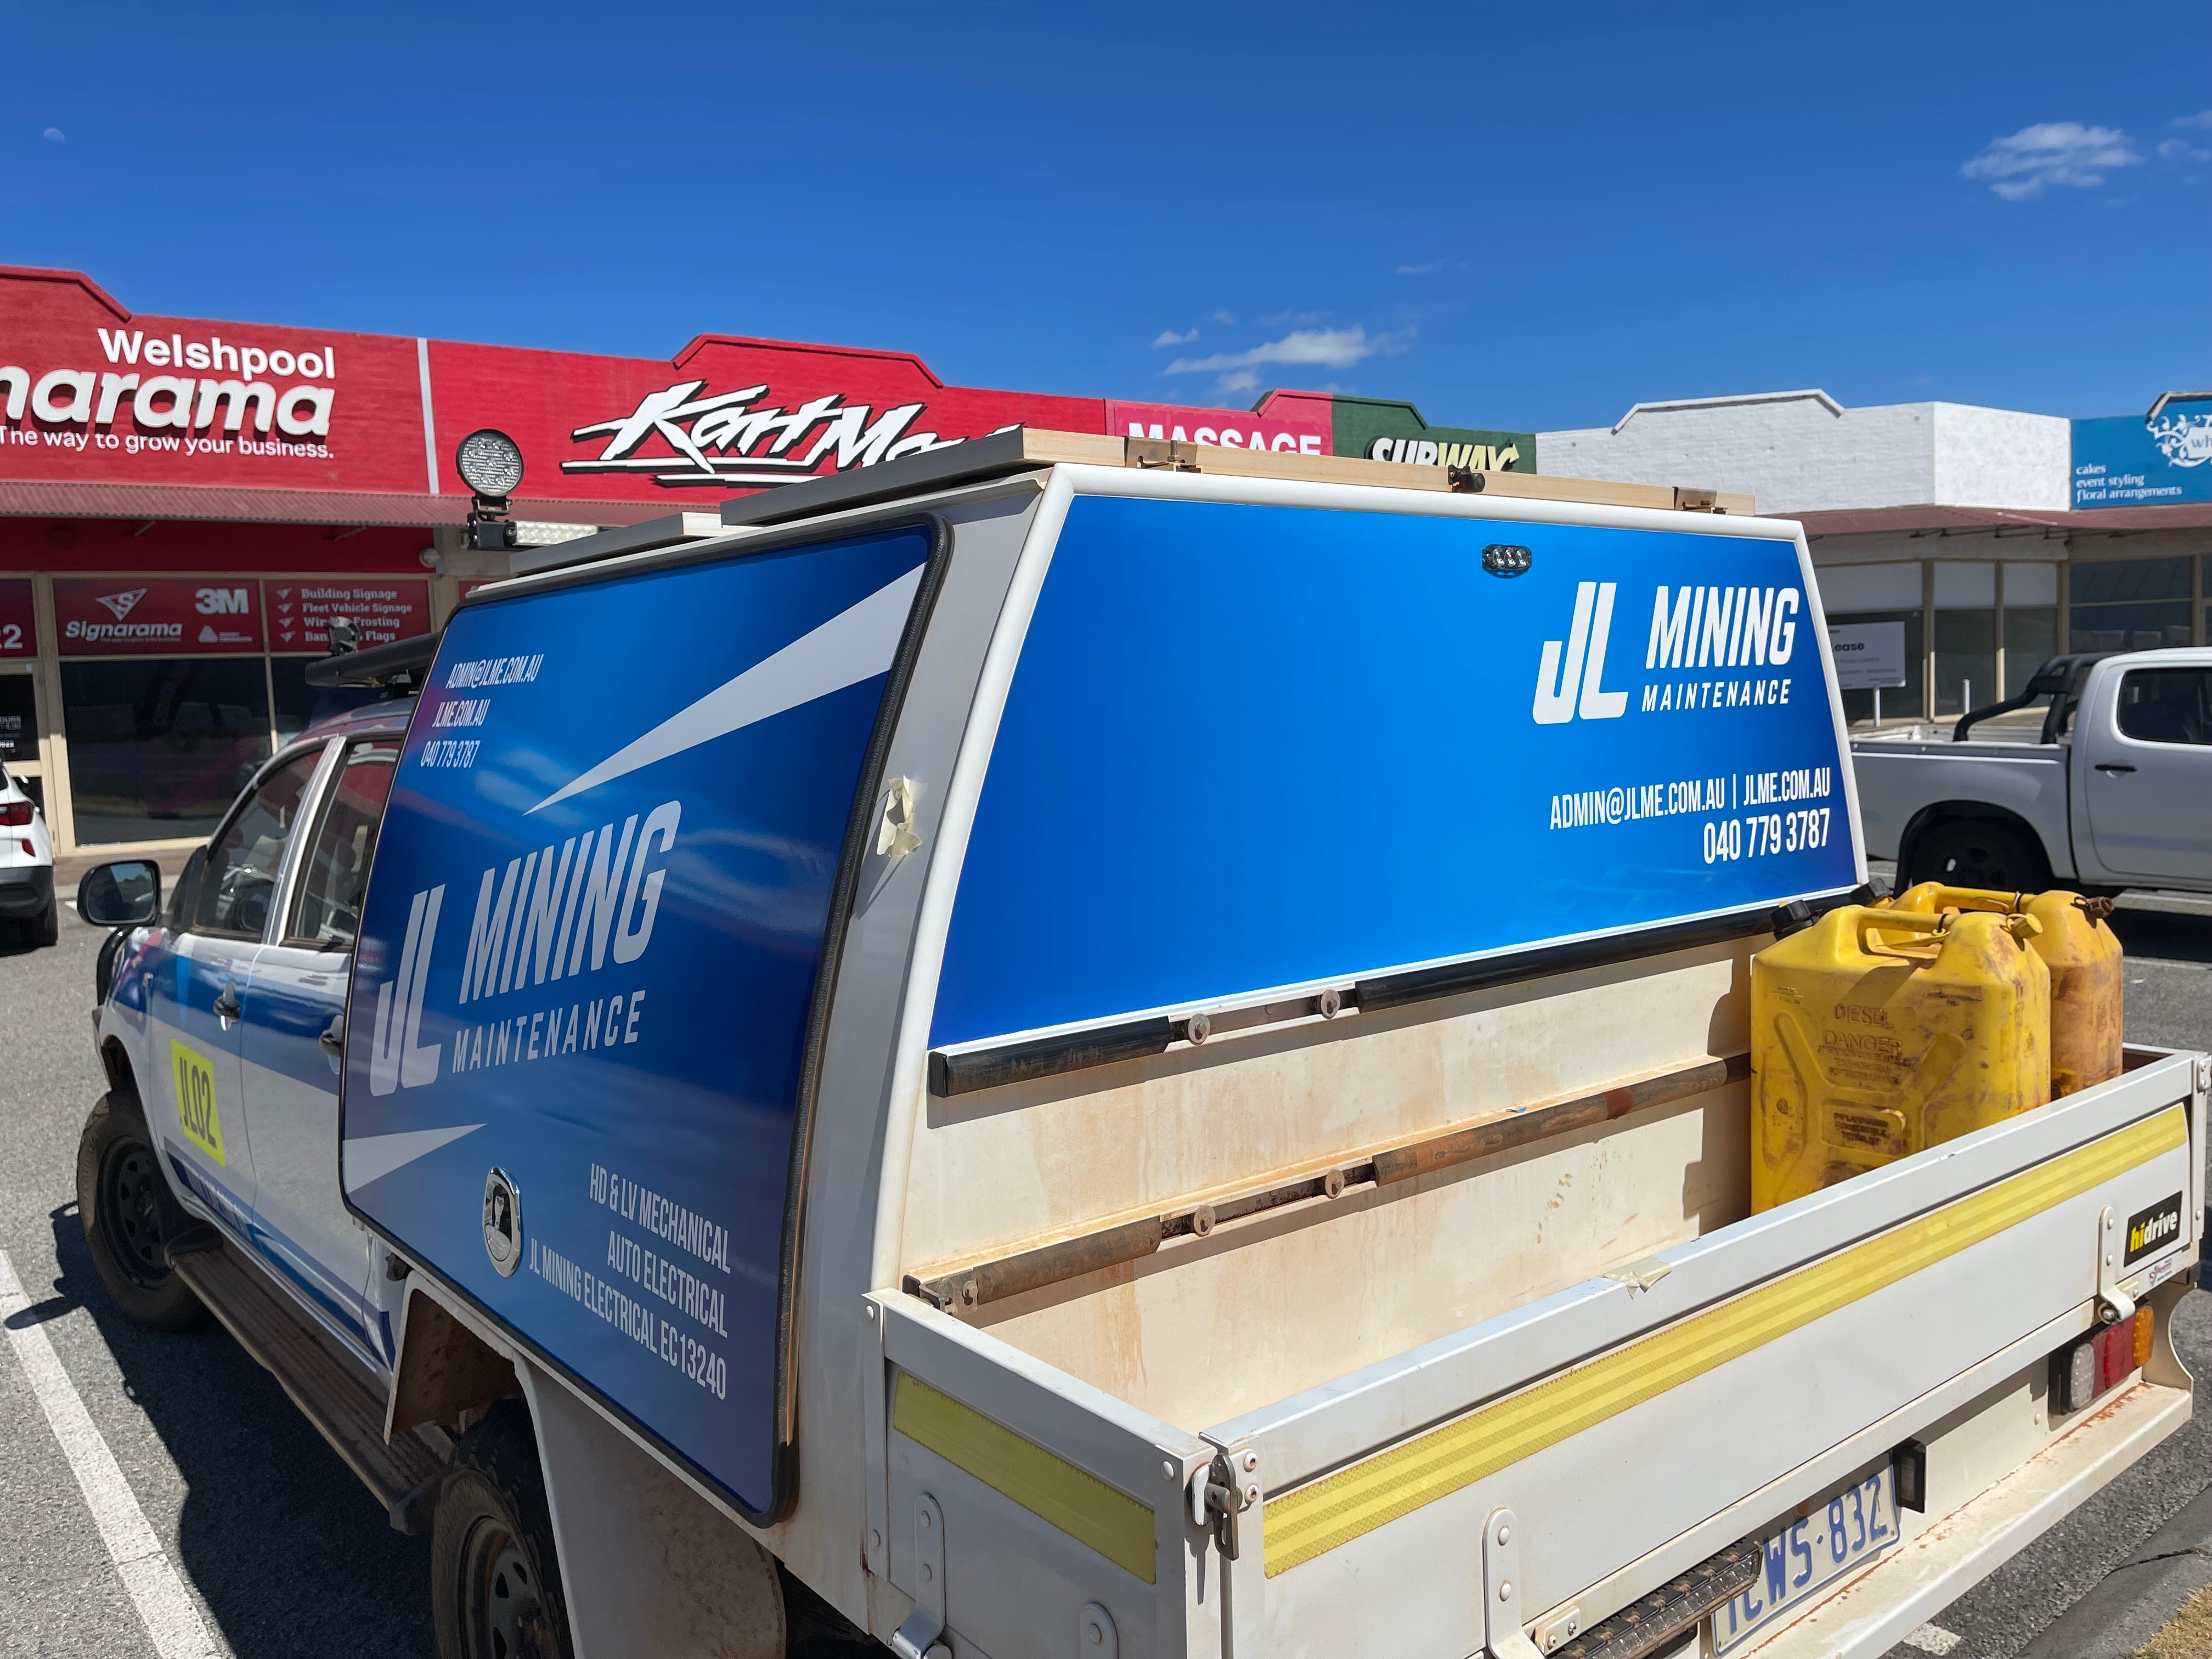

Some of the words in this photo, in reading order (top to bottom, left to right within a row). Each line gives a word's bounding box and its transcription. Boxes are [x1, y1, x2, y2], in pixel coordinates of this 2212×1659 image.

[97, 328, 335, 381] Welshpool
[0, 425, 38, 445] The
[43, 431, 86, 452] way
[95, 432, 120, 450] to
[126, 436, 180, 454] grow
[185, 438, 234, 456] your
[239, 432, 334, 459] business.
[2075, 464, 2106, 476] cakes
[2076, 477, 2106, 488] event
[2109, 474, 2145, 488] styling
[2076, 488, 2106, 504] floral
[2109, 486, 2182, 500] arrangements
[195, 588, 249, 615] 3M
[301, 588, 351, 601] Building
[353, 589, 397, 601] Signage
[302, 603, 329, 613] Fleet
[331, 602, 370, 613] Vehicle
[372, 603, 412, 614] Signage
[0, 623, 23, 650] 2
[65, 620, 183, 642] Signarama
[353, 617, 399, 628] Frosting
[366, 630, 396, 642] Flags
[1646, 585, 1799, 669] MINING
[1532, 582, 1628, 725] JL
[1831, 642, 1865, 652] ease
[445, 654, 544, 689] ADMIN@JLME.COM.AU
[1641, 679, 1791, 712] MAINTENANCE
[432, 699, 491, 728] JLME.COM.AU
[420, 741, 441, 768] 040
[436, 741, 457, 768] 779
[453, 740, 481, 768] 3787
[1550, 776, 1725, 830] ADMIN@JLME.COM.AU
[1743, 766, 1830, 806] JLME.COM.AU
[1703, 818, 1740, 864] 040
[1747, 813, 1781, 858] 779
[1786, 808, 1830, 850] 3787
[459, 800, 681, 1005] MINING
[370, 884, 445, 1096] JL
[452, 990, 646, 1074] MAINTENANCE
[1834, 1003, 1893, 1029] DIESEL
[589, 1163, 607, 1205] HD
[610, 1173, 619, 1212] &
[621, 1178, 637, 1221] LV
[639, 1187, 731, 1274] MECHANICAL
[2130, 1211, 2178, 1252] hidrive
[607, 1231, 641, 1283] AUTO
[644, 1250, 728, 1339] ELECTRICAL
[529, 1238, 540, 1276] JL
[543, 1245, 581, 1302] MINING
[584, 1271, 657, 1355] ELECTRICAL
[661, 1320, 727, 1401] EC13240
